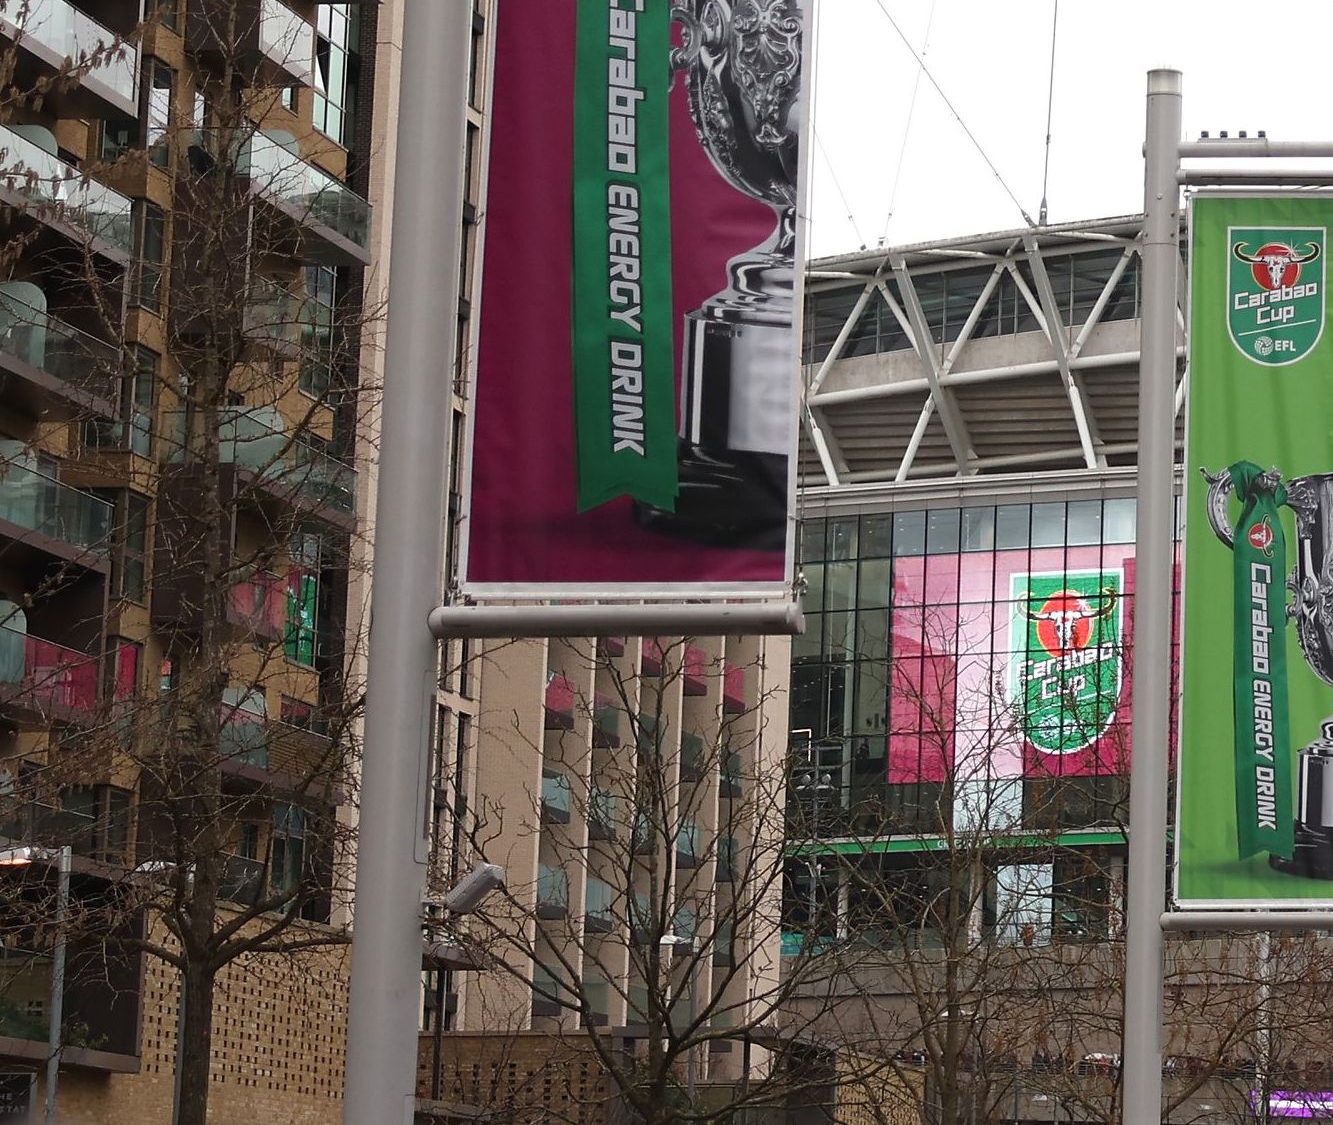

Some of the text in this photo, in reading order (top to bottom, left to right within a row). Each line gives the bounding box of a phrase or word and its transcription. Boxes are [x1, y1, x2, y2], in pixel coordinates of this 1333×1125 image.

[608, 184, 641, 333] ENERGY
[1234, 282, 1318, 310] Carabao
[1256, 306, 1295, 325] Cup
[1274, 340, 1297, 352] EFL
[611, 341, 645, 457] DRINK
[1251, 562, 1277, 831] Carabao ENERGY DRINK
